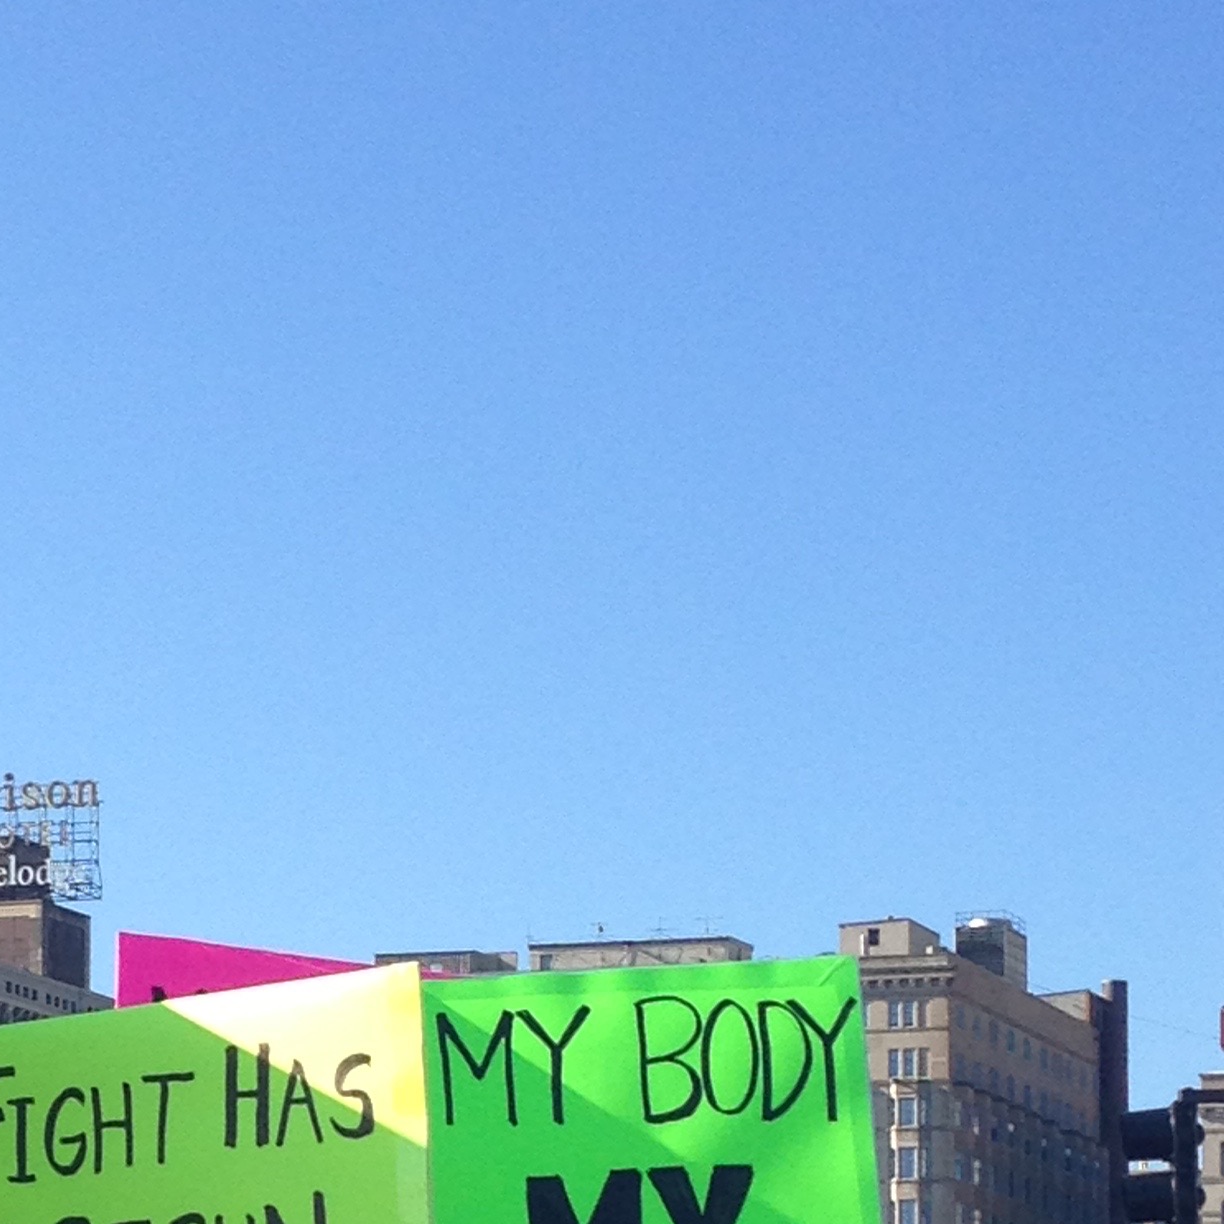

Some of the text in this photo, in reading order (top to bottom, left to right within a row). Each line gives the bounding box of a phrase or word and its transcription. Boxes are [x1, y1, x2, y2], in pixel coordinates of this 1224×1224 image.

[224, 1042, 375, 1149] HAS
[436, 996, 857, 1127] MY BODY
